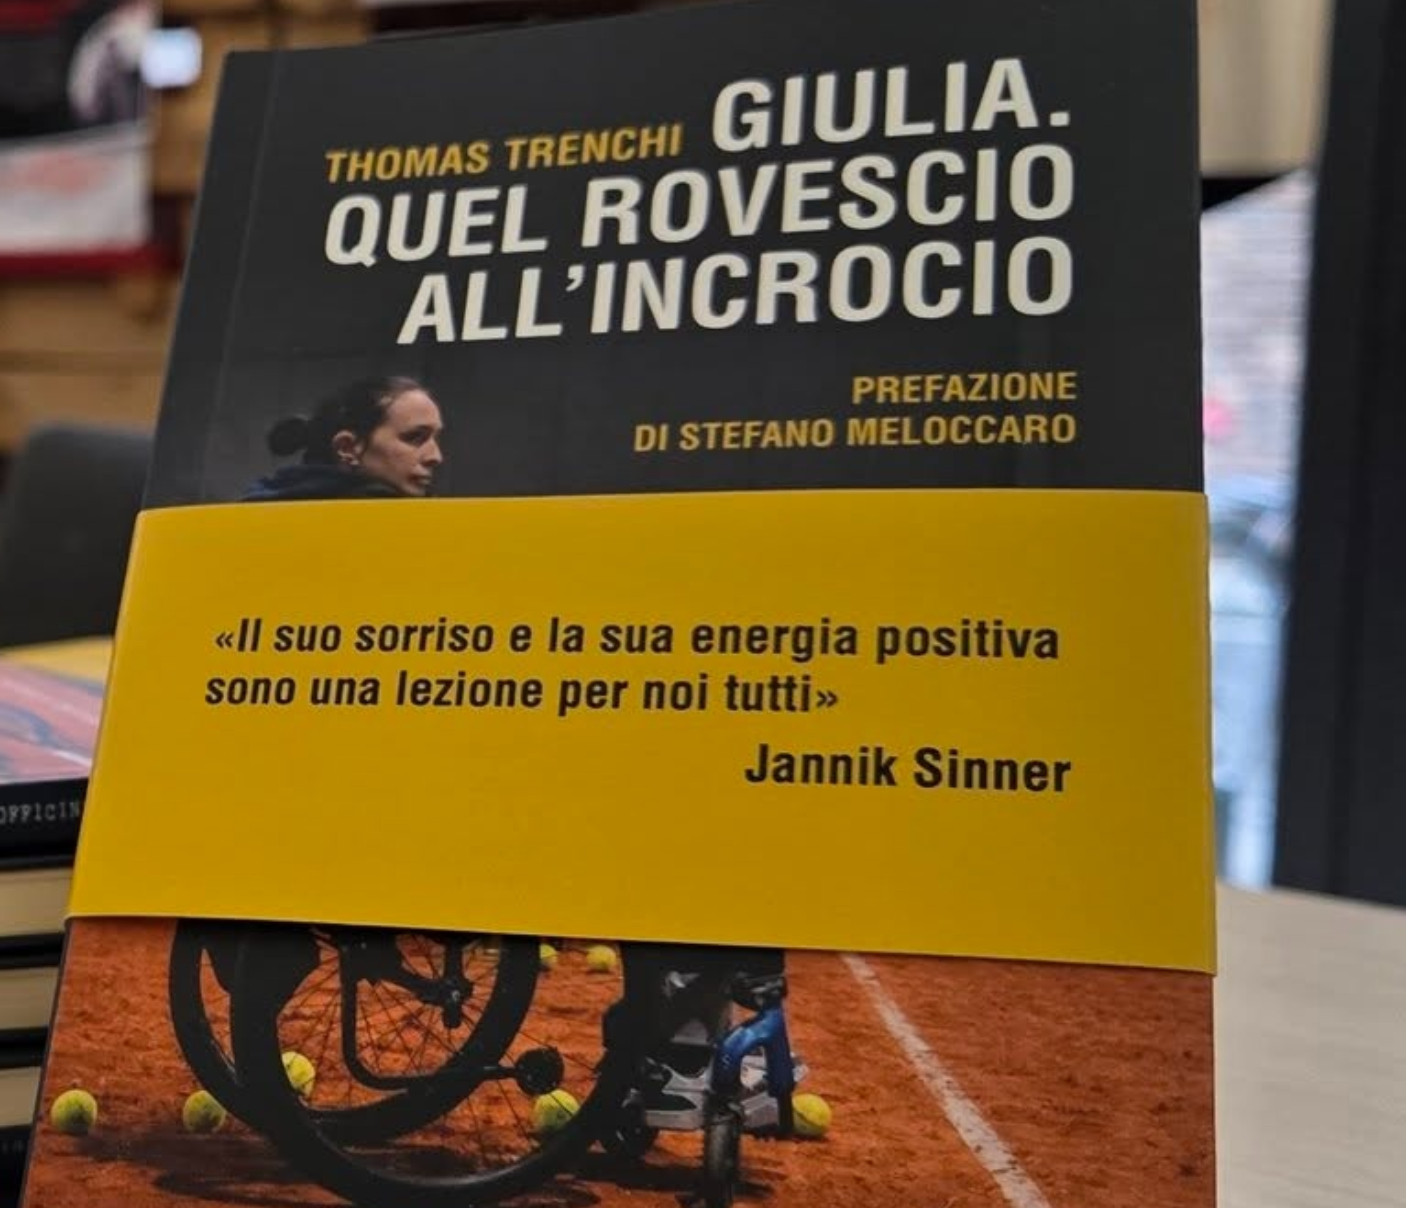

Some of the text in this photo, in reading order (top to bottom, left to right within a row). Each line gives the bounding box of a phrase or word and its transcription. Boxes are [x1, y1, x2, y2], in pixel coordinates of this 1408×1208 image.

[324, 57, 1072, 184] THOMAS TRENCHI GIULIA.
[324, 143, 1075, 269] QUEL ROVESCIO
[850, 370, 1078, 405] PREFAZIONE
[633, 412, 1078, 453] DI STEFANO MELOCCARO
[273, 624, 343, 653] suo
[354, 616, 495, 653] sorriso
[509, 624, 533, 653] e
[548, 616, 585, 654] la
[599, 624, 674, 654] sua
[690, 616, 859, 664] energia
[876, 617, 1059, 666] positiva
[204, 669, 839, 718] sono una lezione per noi tutti»
[744, 742, 1073, 794] Jannik Sinner
